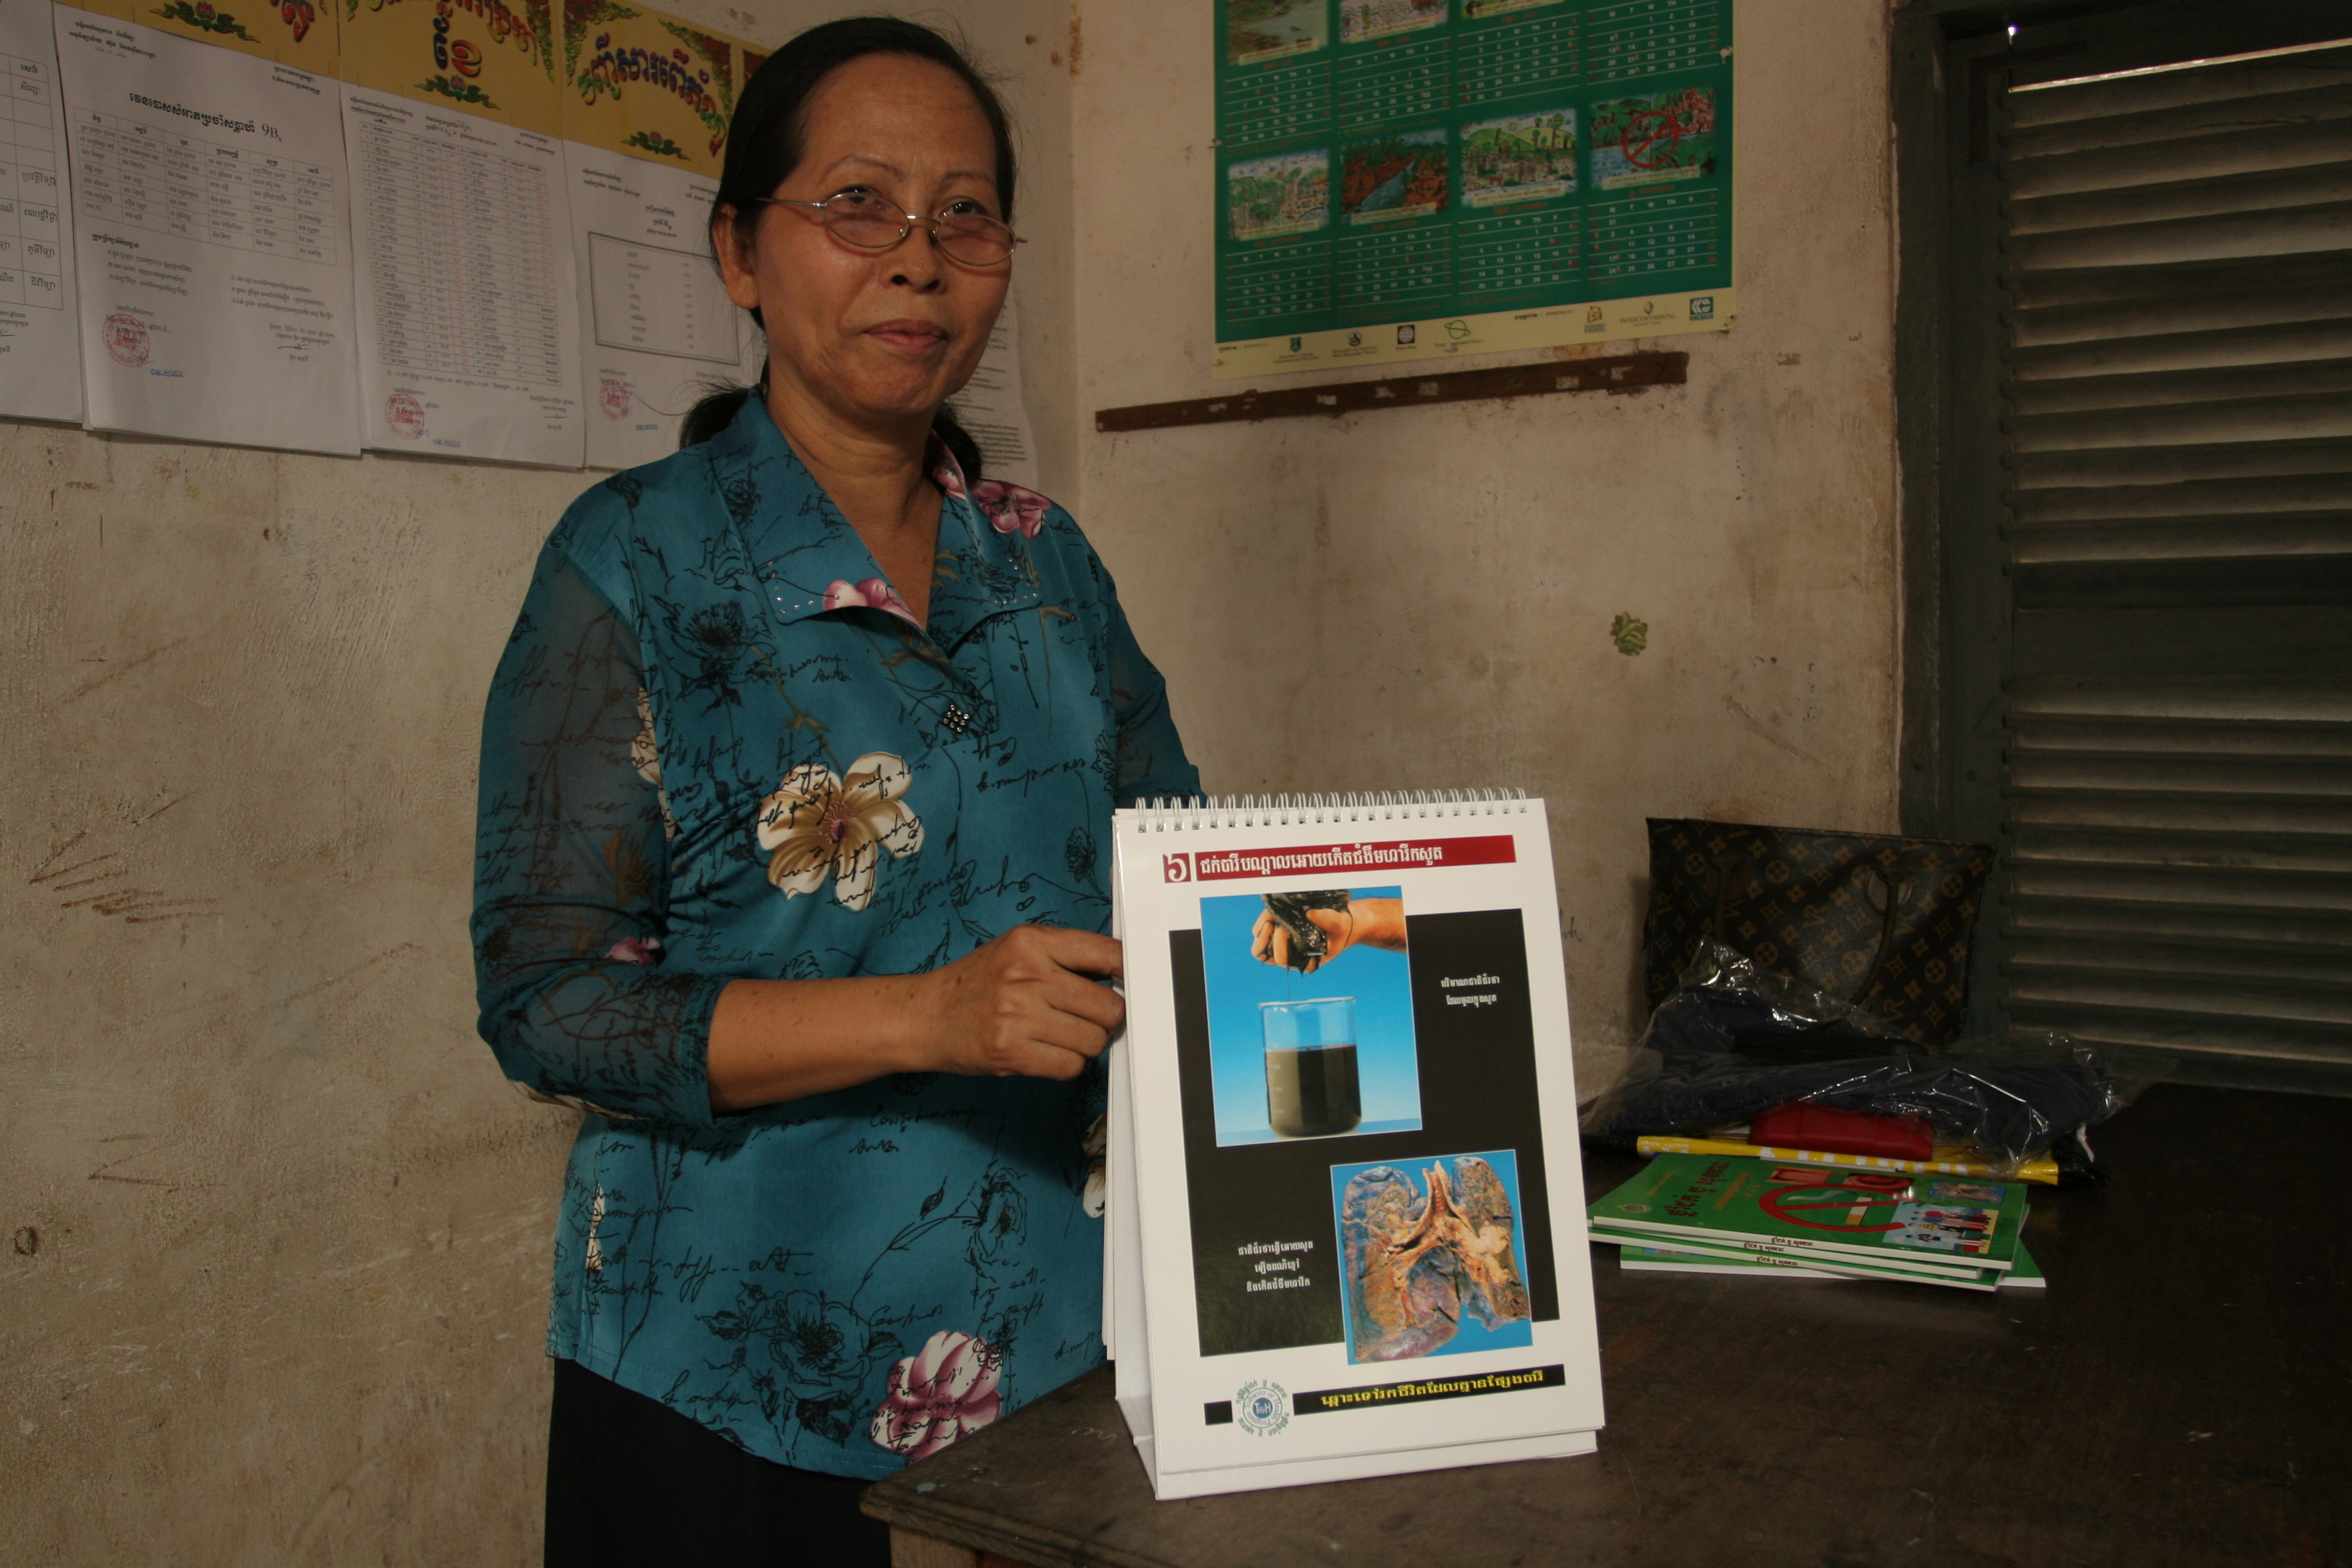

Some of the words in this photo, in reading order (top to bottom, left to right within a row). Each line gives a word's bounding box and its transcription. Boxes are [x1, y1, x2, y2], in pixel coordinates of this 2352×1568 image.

[1167, 853, 1187, 882] ៦
[1244, 1391, 1266, 1408] Tobacco
[1270, 1398, 1282, 1421] Health
[1247, 1411, 1273, 1428] Program
